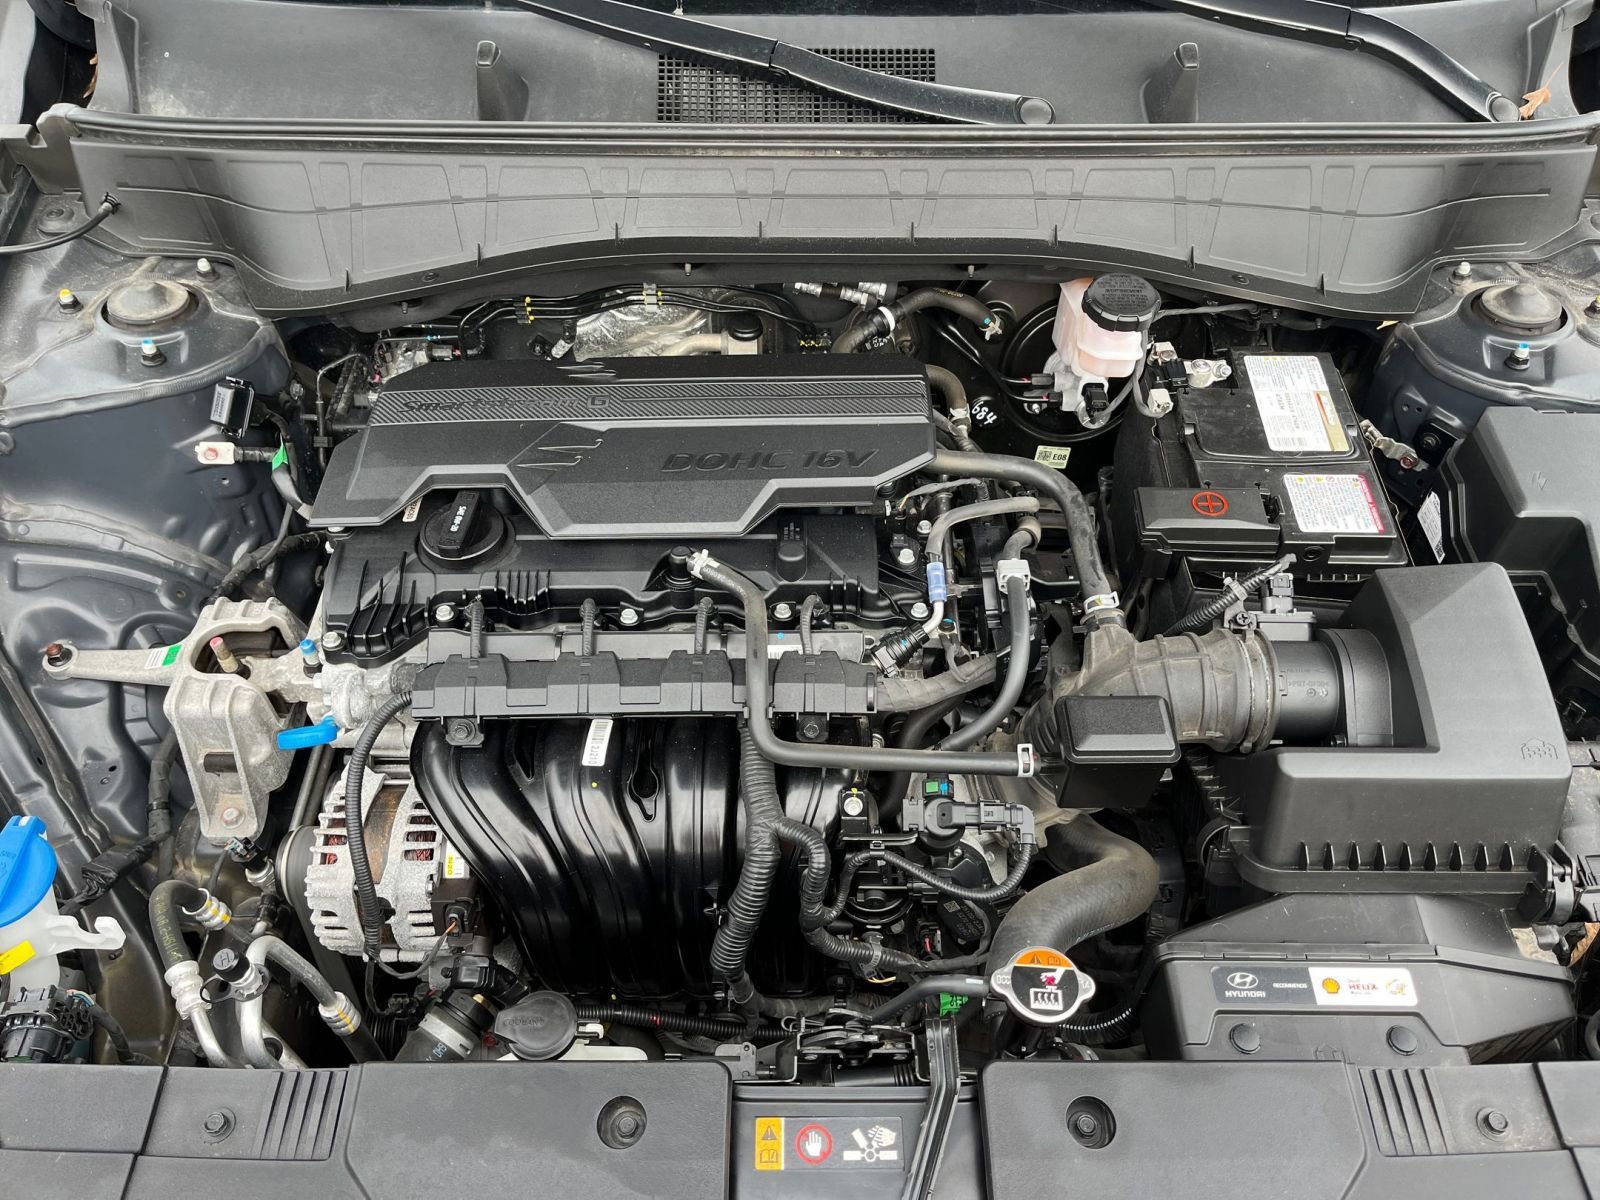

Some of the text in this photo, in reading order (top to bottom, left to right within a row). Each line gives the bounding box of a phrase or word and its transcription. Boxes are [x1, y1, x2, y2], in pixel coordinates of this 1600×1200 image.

[971, 401, 998, 425] 684
[661, 449, 879, 472] DOHC 16V
[1052, 453, 1067, 461] E08
[1225, 990, 1266, 998] HYUNDAI
